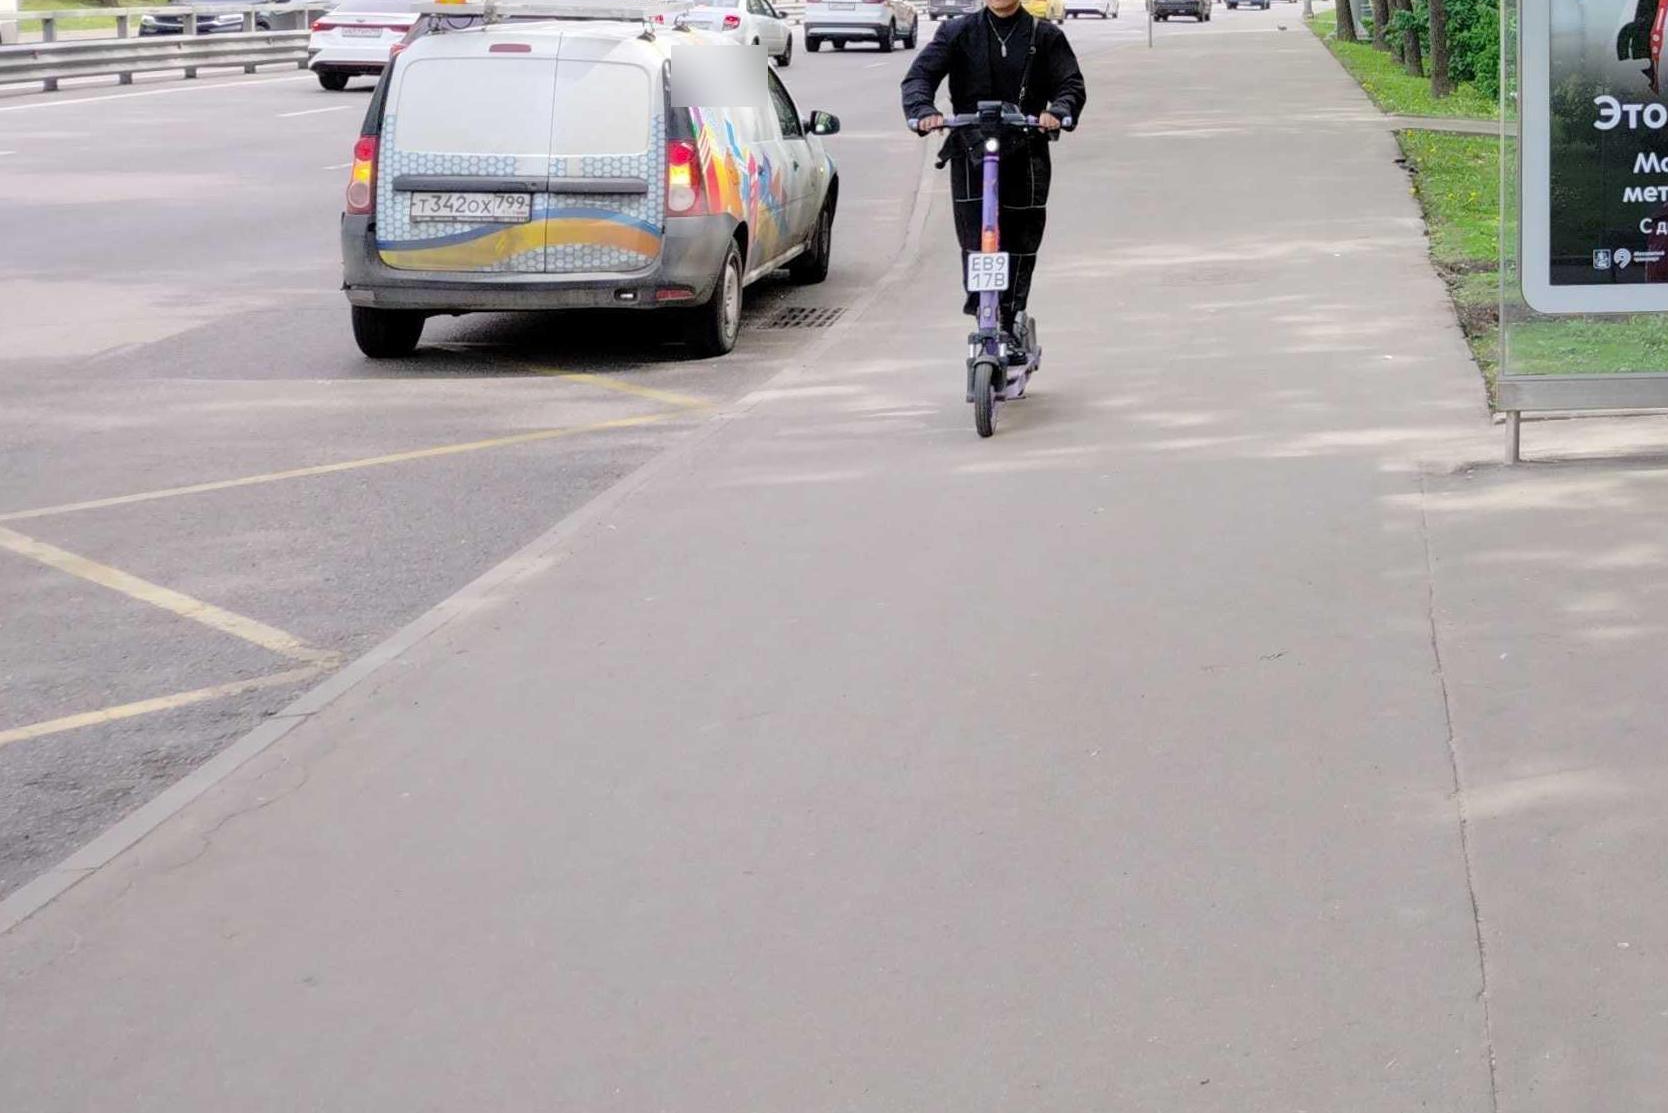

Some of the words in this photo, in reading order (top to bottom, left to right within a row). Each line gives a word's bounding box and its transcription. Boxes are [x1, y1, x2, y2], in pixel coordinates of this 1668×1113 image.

[1593, 94, 1668, 131] Это
[495, 194, 525, 209] 799
[1639, 217, 1653, 234] С
